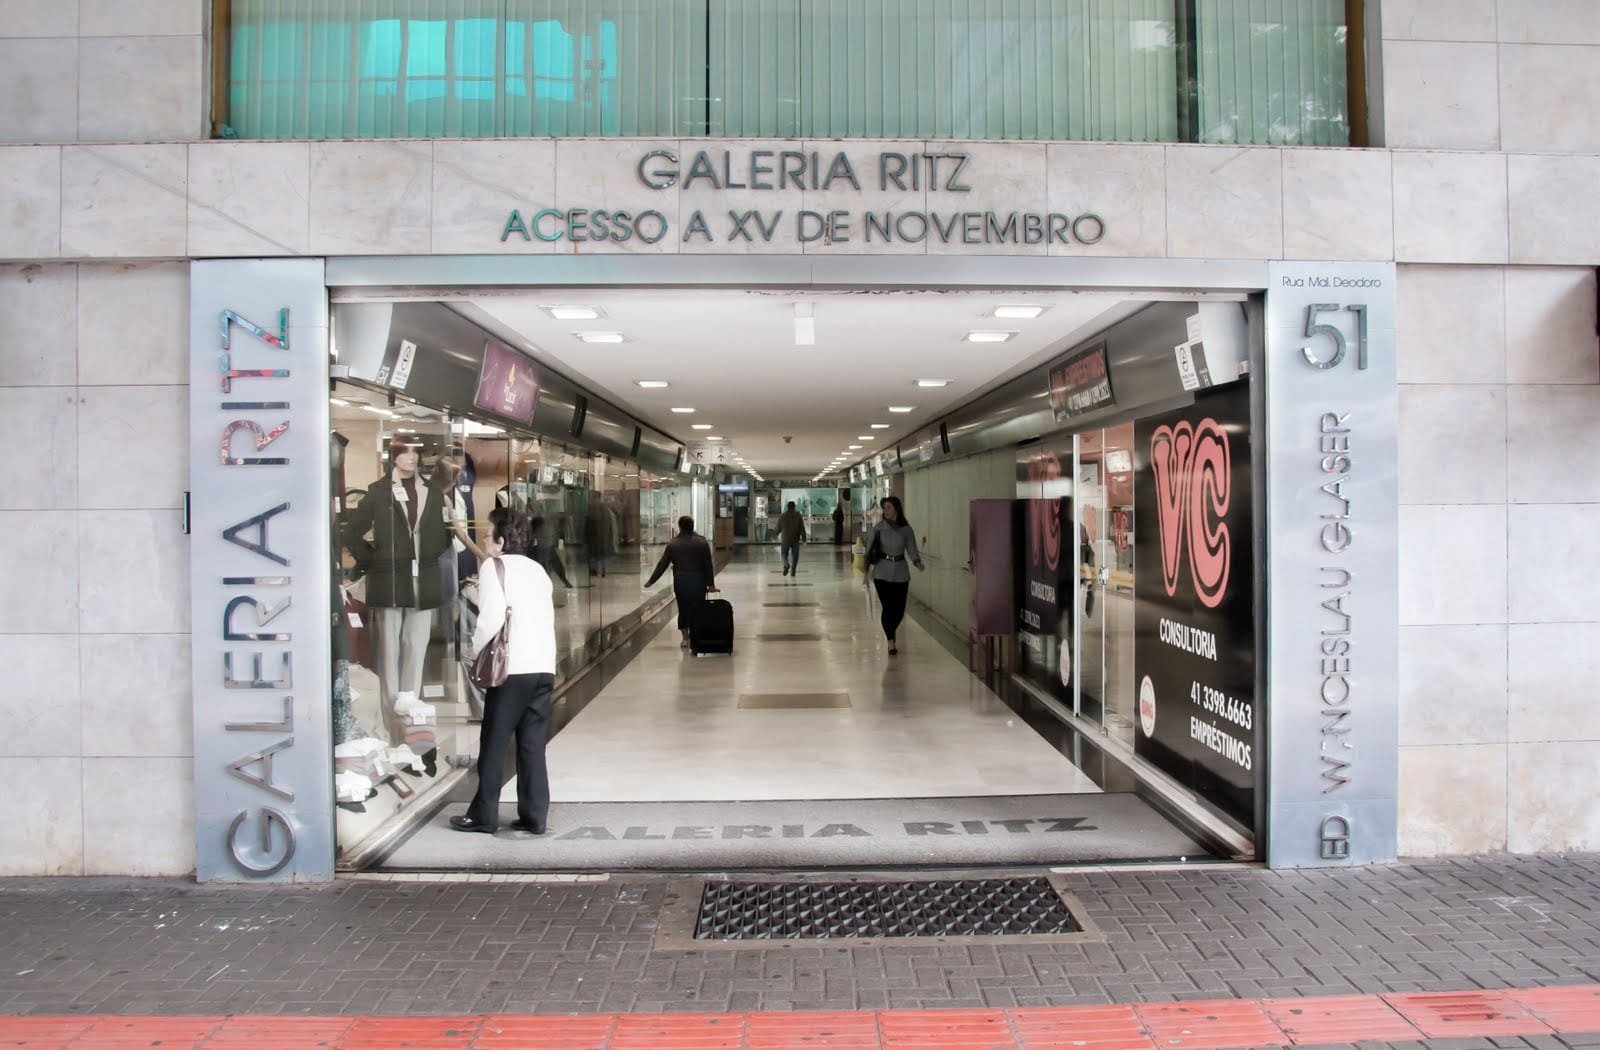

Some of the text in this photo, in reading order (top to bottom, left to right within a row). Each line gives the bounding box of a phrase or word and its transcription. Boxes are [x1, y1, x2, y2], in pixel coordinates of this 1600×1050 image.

[638, 150, 972, 191] GALERIA RITZ
[500, 208, 1106, 245] ACESSO A XV DE NOVEMBRO
[1281, 276, 1305, 288] Rua
[1333, 276, 1383, 288] Deodoro
[1300, 303, 1368, 371] 51
[1320, 411, 1352, 554] GLASER
[1151, 417, 1231, 608] VC
[220, 307, 297, 878] GALERIA RITZ
[1159, 617, 1217, 661] CONSULTORIA
[1190, 680, 1252, 730] 41 3398.6663
[1190, 716, 1252, 770] EMPRÉSTIMOS
[903, 816, 1099, 837] RITZ
[1319, 815, 1352, 861] ED
